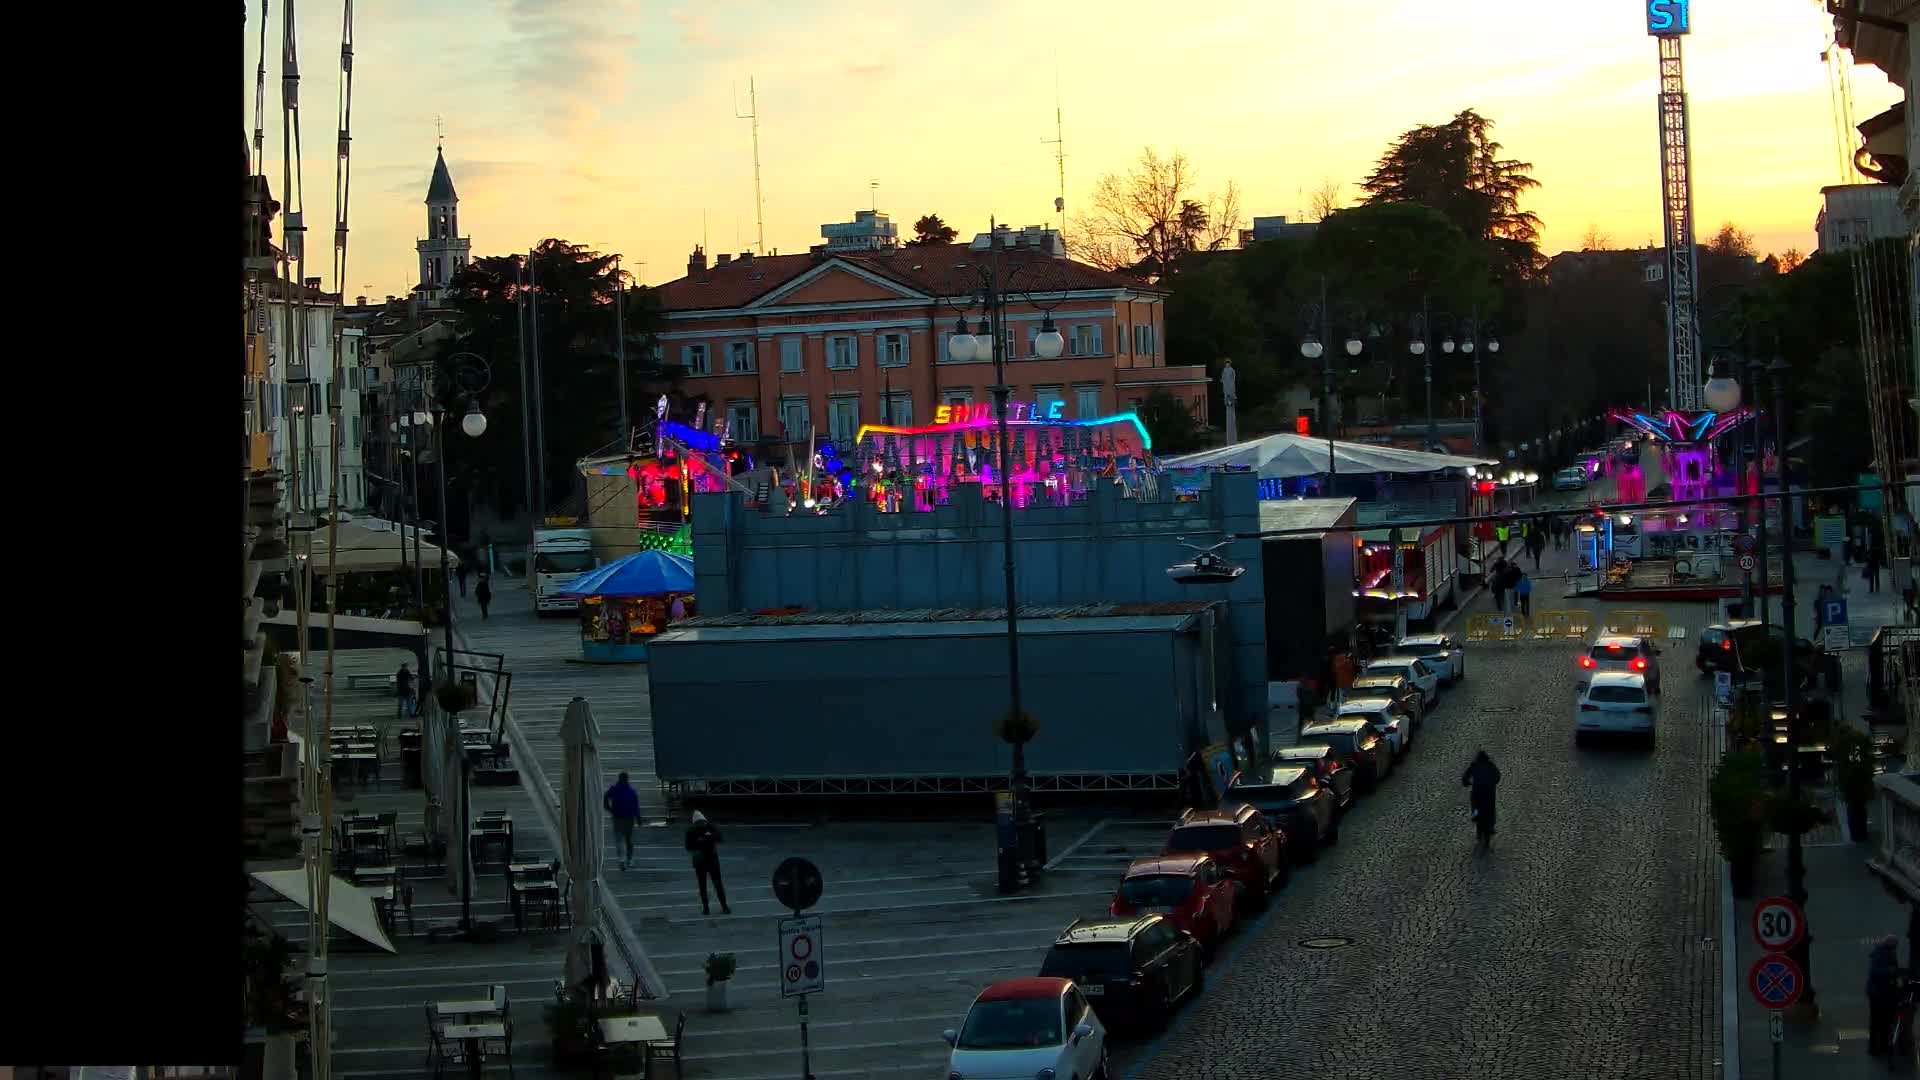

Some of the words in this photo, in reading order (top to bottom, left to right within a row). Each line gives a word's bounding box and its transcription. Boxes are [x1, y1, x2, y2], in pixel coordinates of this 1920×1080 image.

[934, 400, 1066, 424] SHUTLE
[1742, 558, 1752, 567] 20
[1827, 602, 1841, 622] P
[1762, 911, 1791, 937] 30
